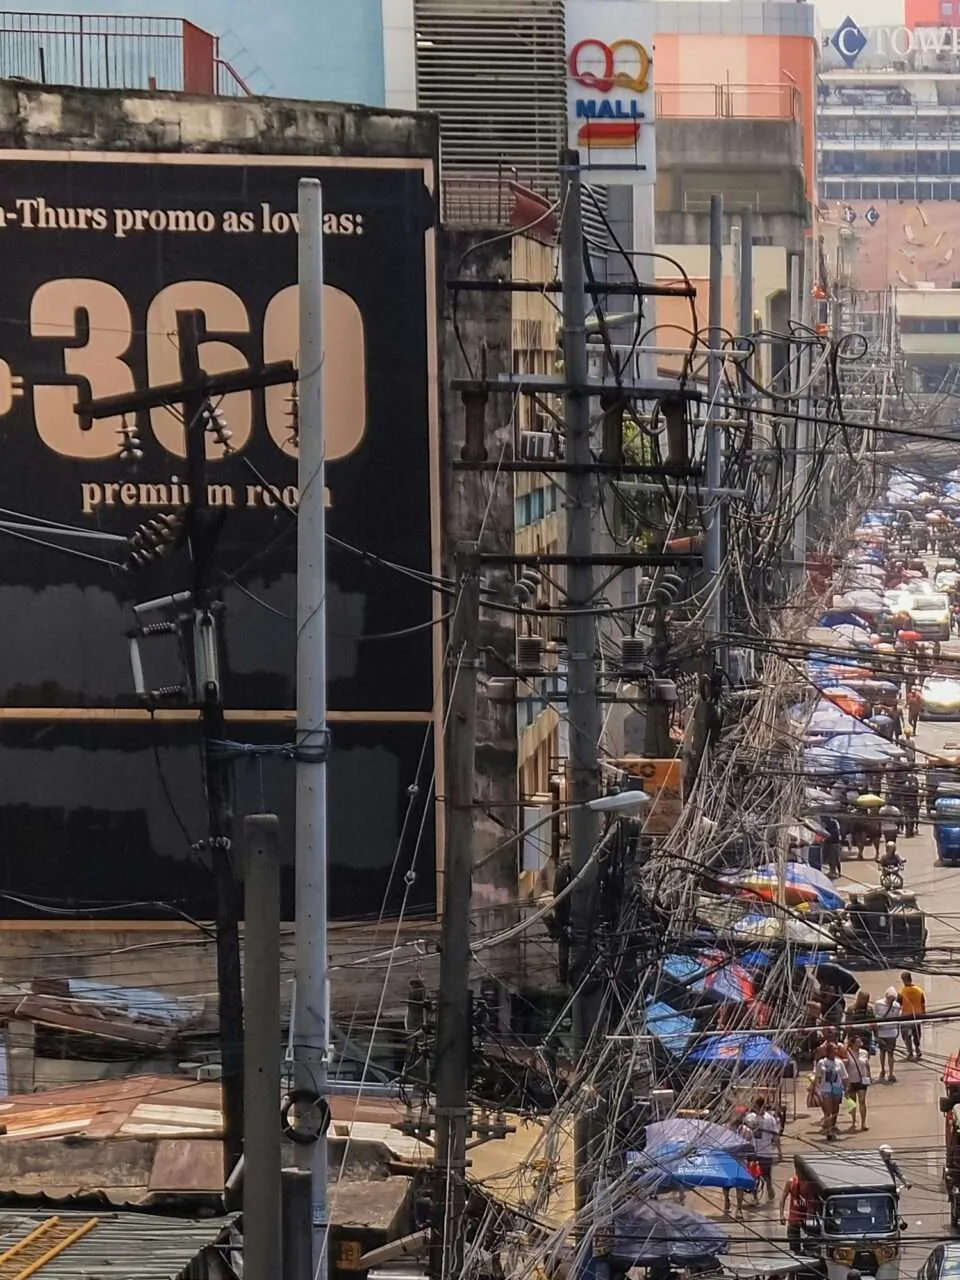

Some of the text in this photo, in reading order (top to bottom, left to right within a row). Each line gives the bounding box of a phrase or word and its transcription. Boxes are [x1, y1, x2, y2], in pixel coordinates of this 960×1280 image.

[838, 27, 860, 56] C
[570, 39, 649, 93] QQ
[576, 99, 645, 118] MALL
[114, 206, 215, 238] promo
[223, 210, 254, 233] as
[81, 476, 332, 513] premim roo
